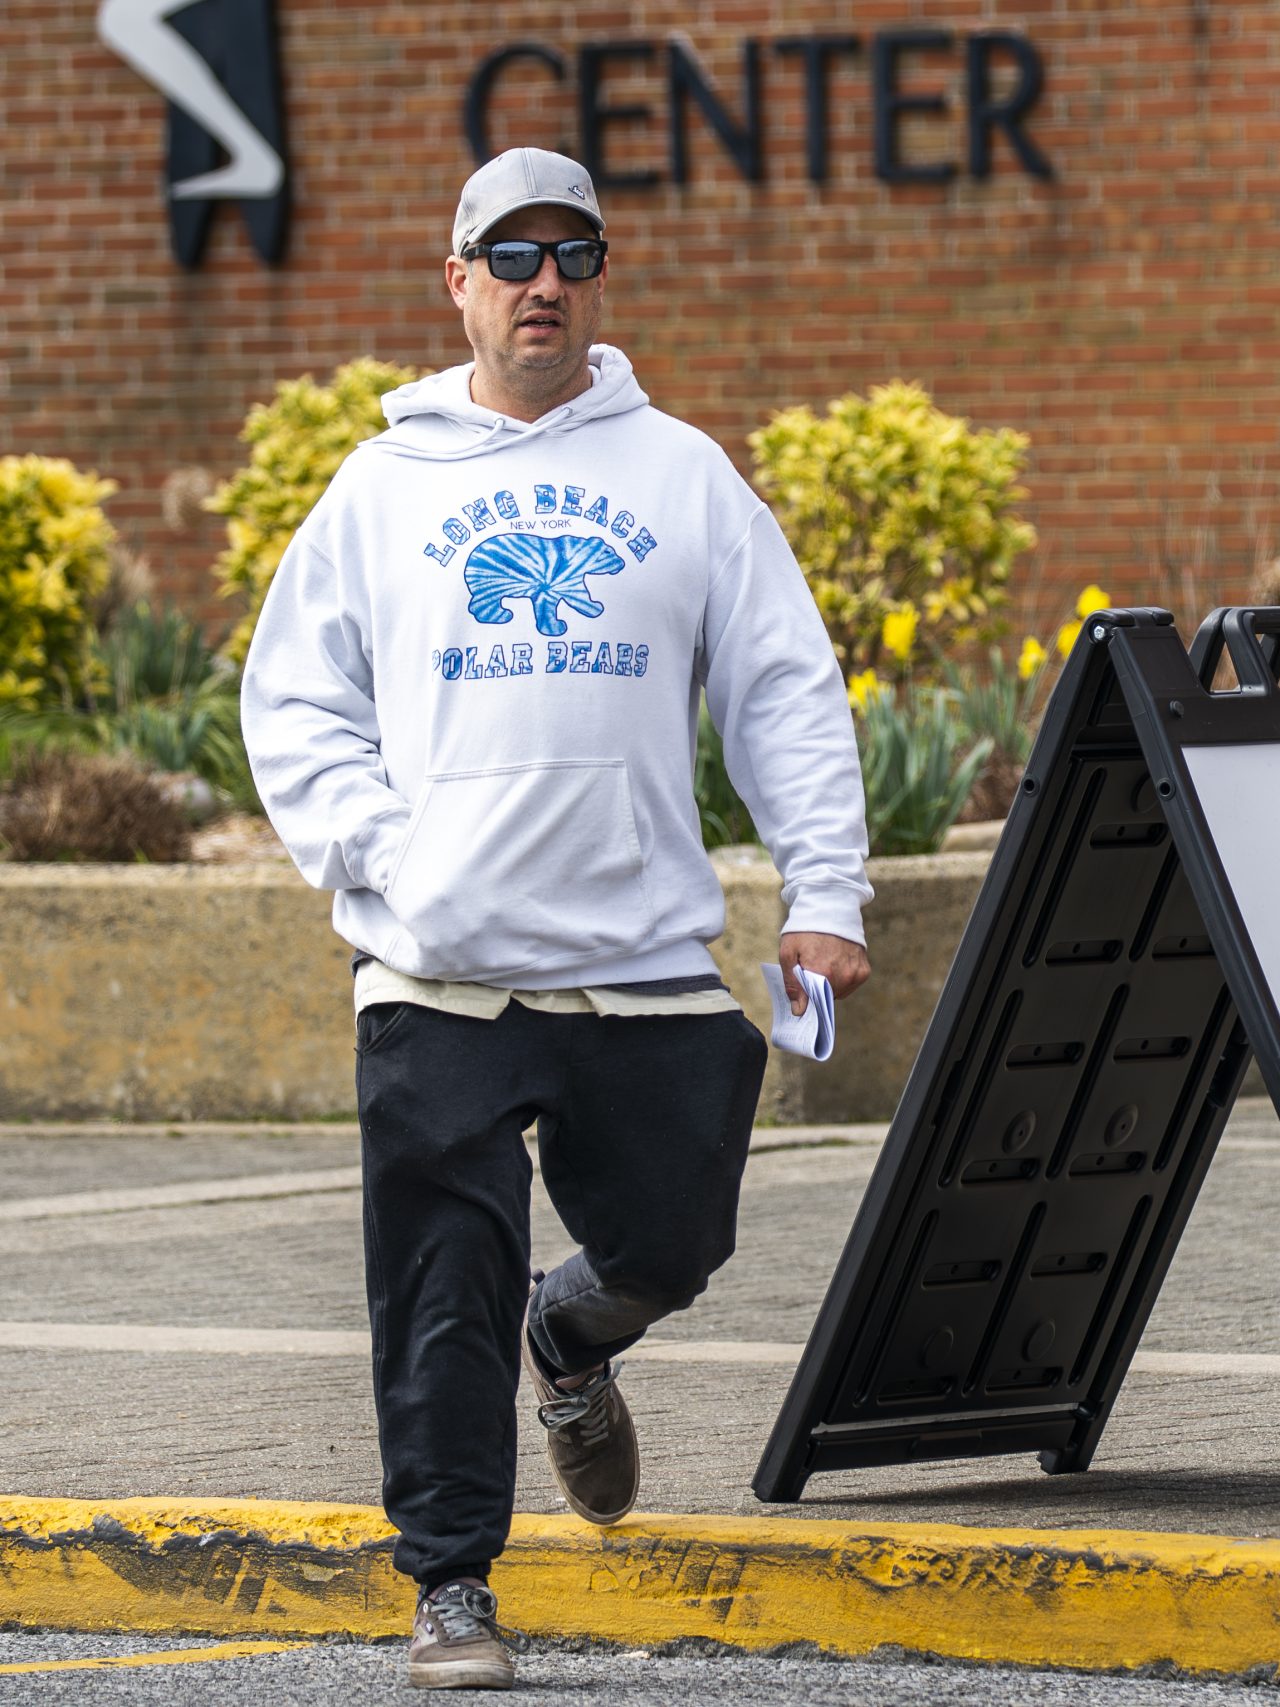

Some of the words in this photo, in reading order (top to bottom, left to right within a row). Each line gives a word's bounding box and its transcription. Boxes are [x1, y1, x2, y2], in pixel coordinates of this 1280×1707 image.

[464, 28, 1055, 190] CENTER
[424, 490, 520, 567] LONG
[534, 484, 658, 562] BEACH
[510, 520, 538, 530] NEW
[541, 518, 572, 529] YORK
[545, 641, 650, 677] BEARS
